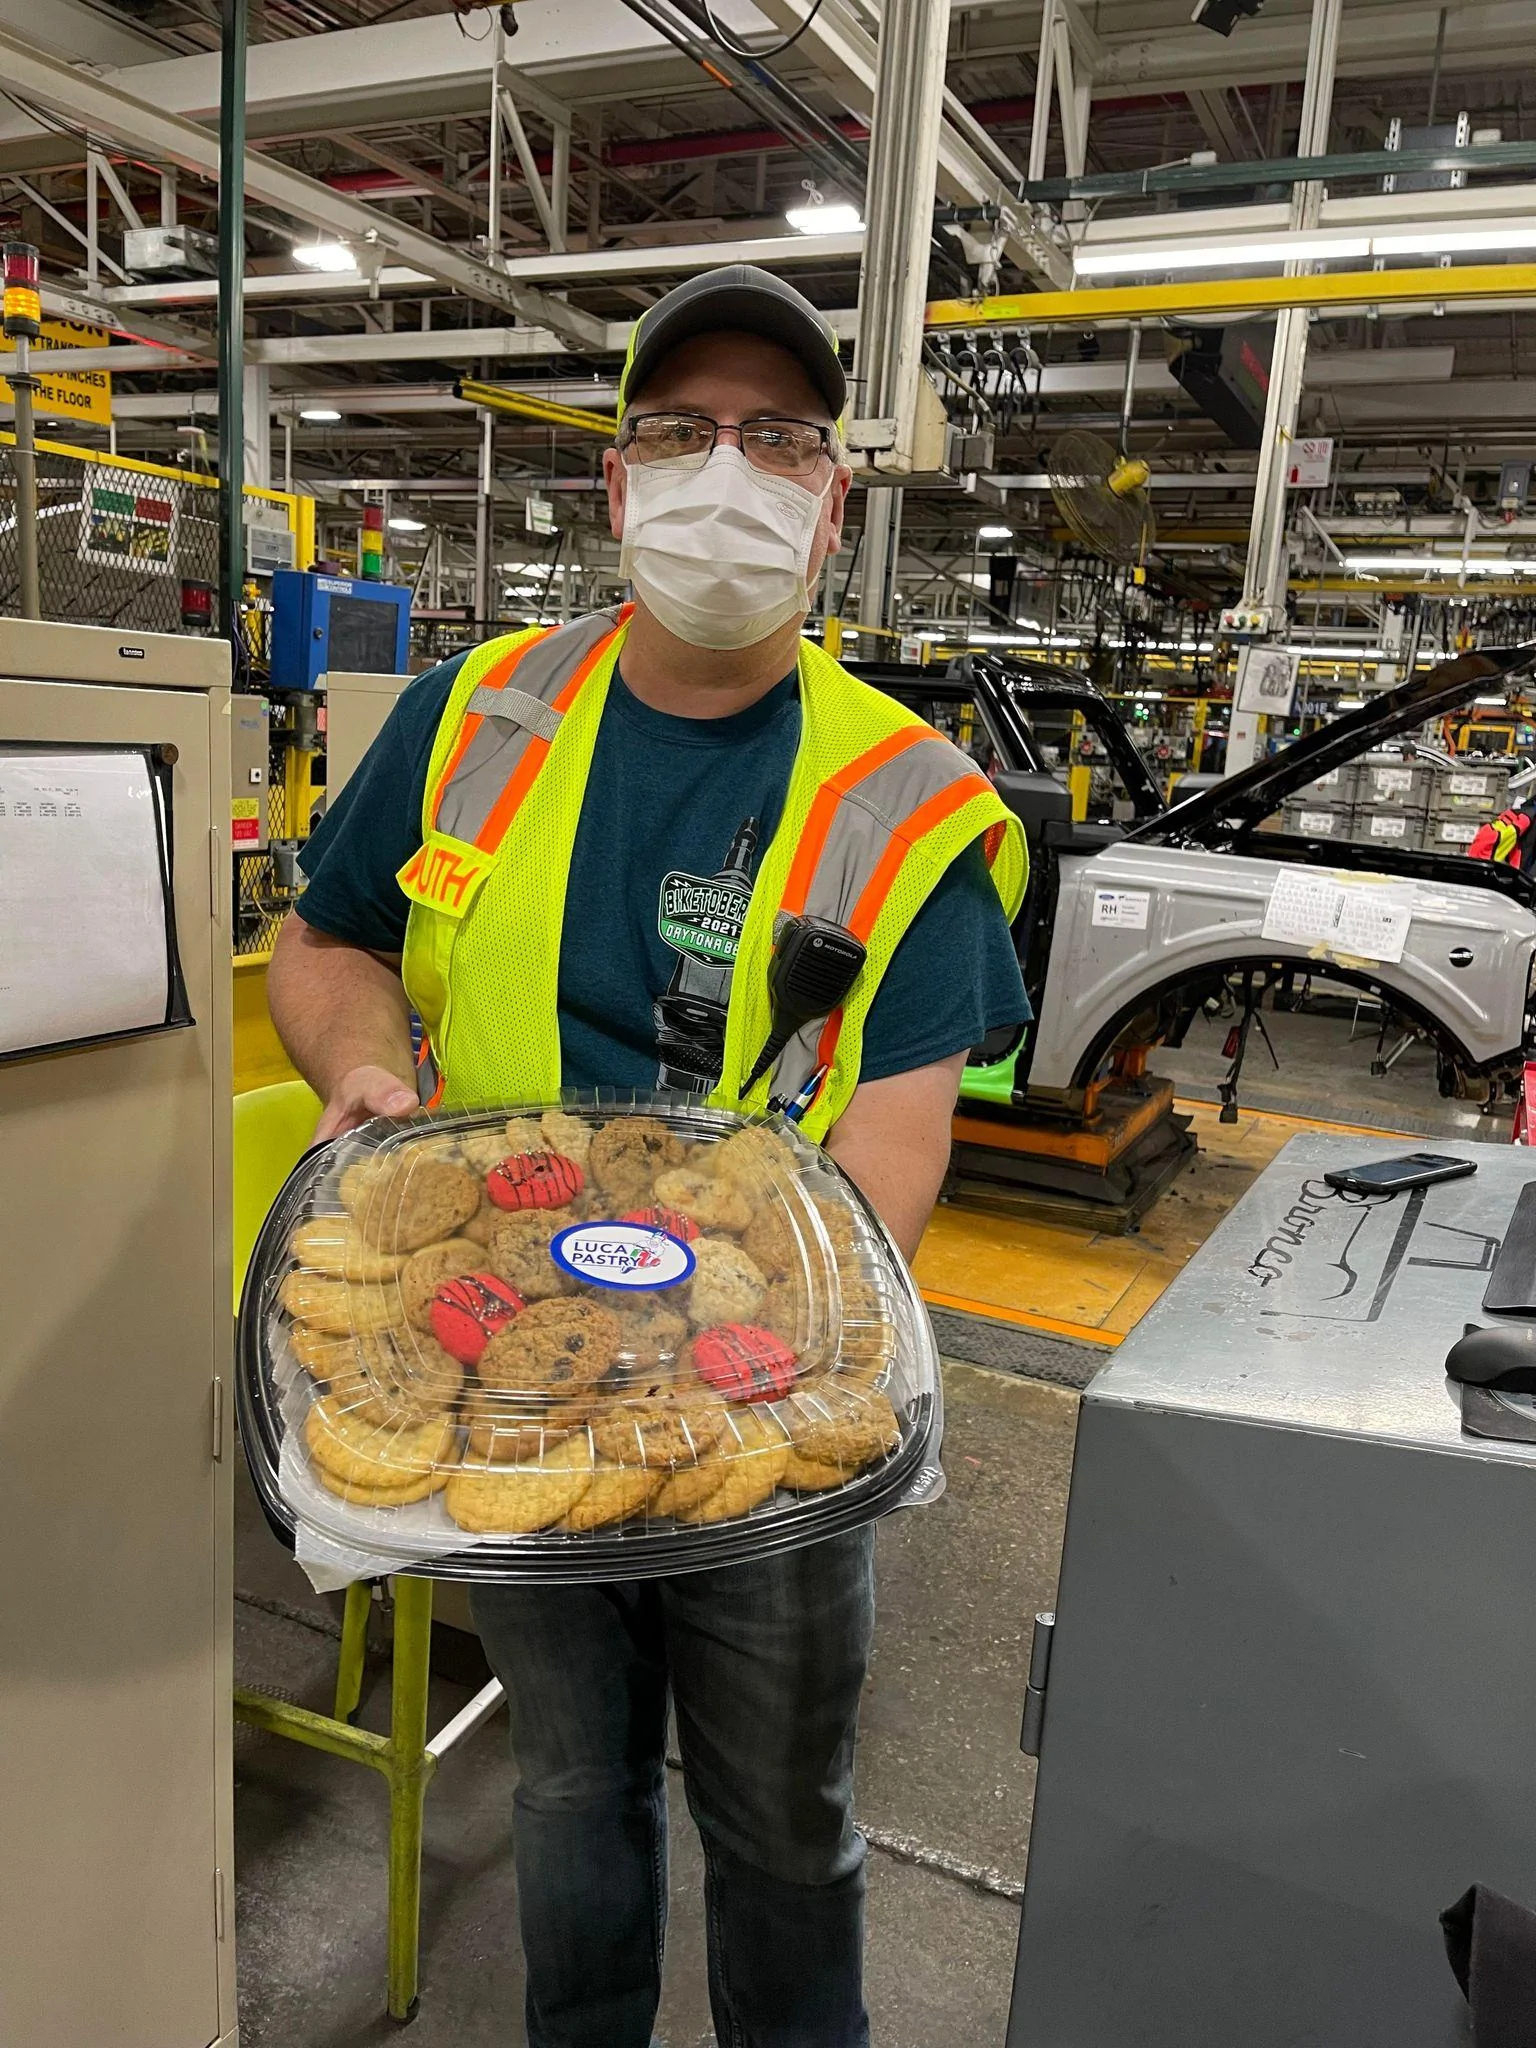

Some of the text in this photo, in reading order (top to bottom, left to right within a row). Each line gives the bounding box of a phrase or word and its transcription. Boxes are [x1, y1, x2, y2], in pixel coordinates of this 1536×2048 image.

[57, 388, 91, 408] FLOOR
[1101, 904, 1117, 915] RH
[701, 916, 738, 937] 2021
[666, 924, 722, 952] DAYTONA
[824, 944, 858, 959] MOTOROLA
[574, 1241, 628, 1255] LUCA
[571, 1252, 641, 1267] PASTRY
